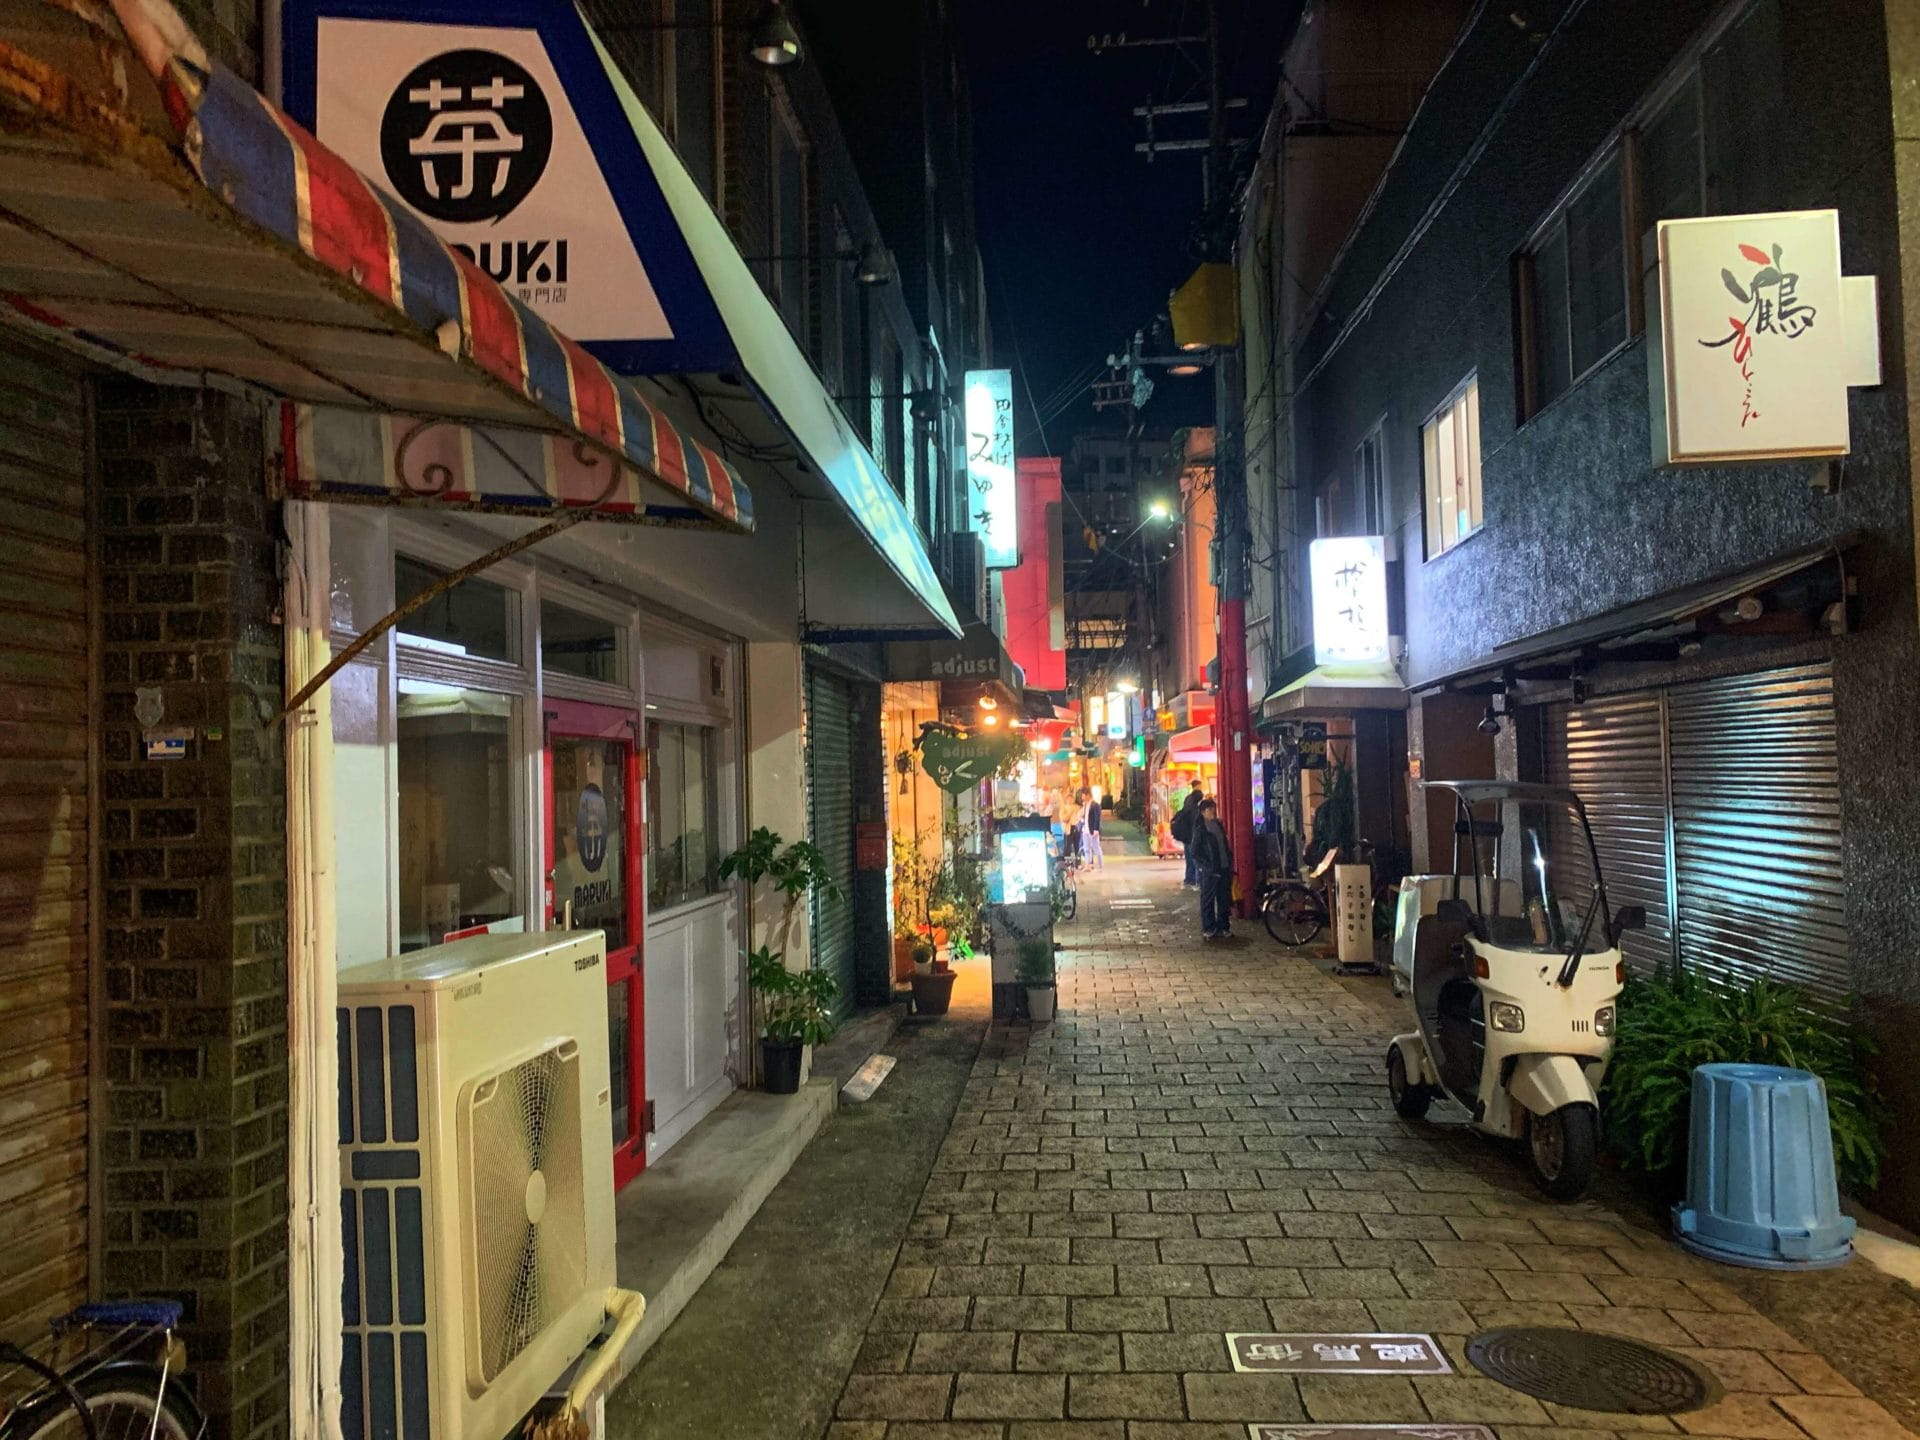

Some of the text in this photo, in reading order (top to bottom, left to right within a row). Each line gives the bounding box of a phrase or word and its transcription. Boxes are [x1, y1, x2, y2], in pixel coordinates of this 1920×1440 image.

[931, 653, 996, 677] adjust
[942, 744, 991, 759] adjust
[574, 879, 612, 909] MARUKI
[574, 953, 600, 972] TOSHIBA
